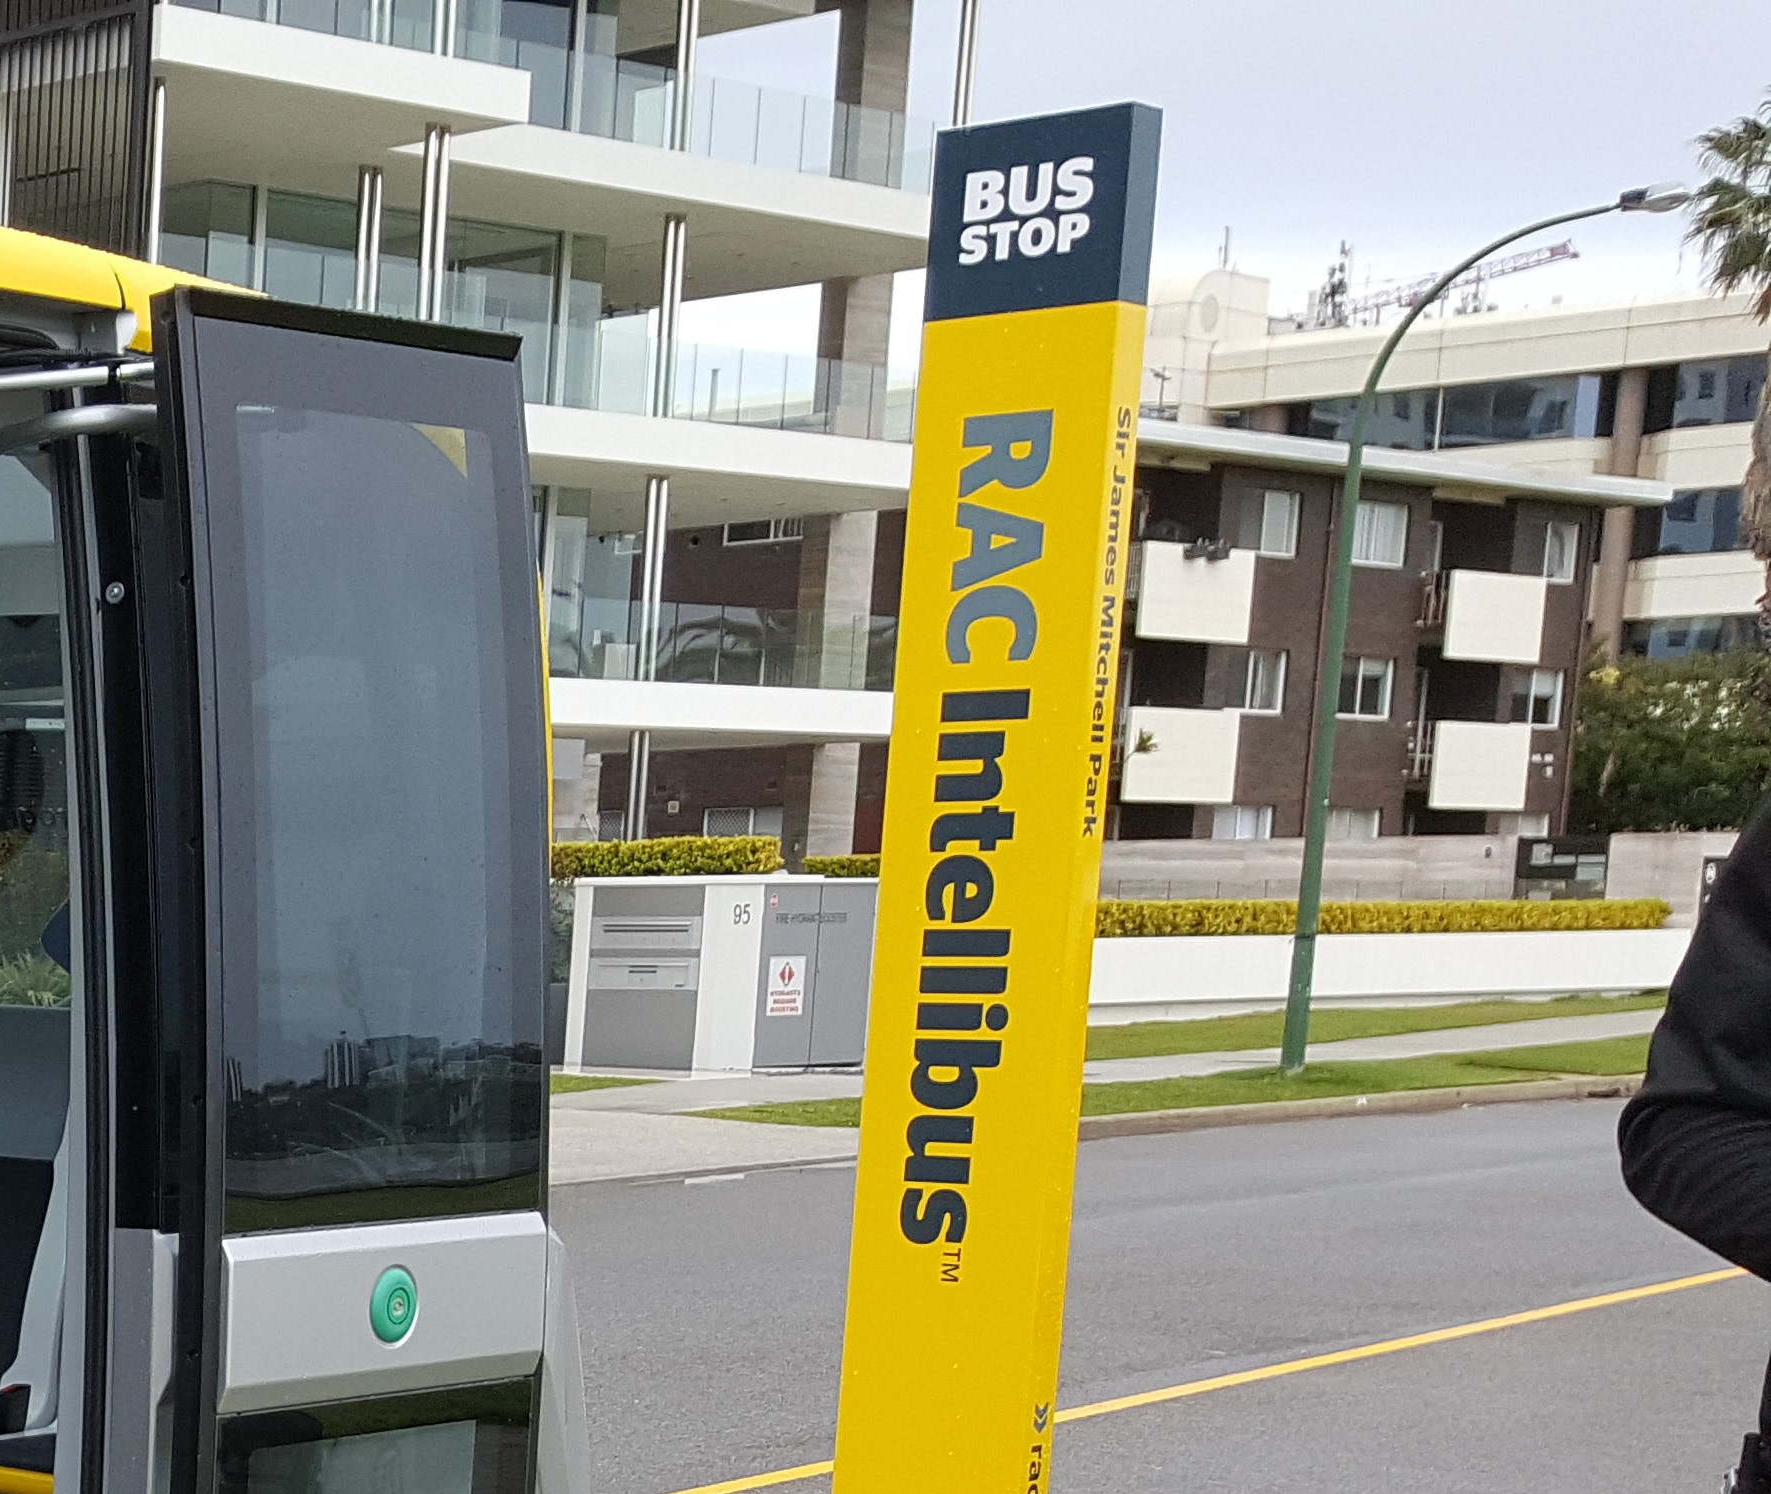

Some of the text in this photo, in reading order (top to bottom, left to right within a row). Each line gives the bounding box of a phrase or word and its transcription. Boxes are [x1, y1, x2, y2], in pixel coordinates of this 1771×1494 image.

[962, 156, 1095, 224] BUS
[959, 213, 1091, 266] STOP
[945, 408, 1054, 665] RAC
[1082, 405, 1132, 839] Sir James Mitchell Park
[733, 904, 751, 925] 95
